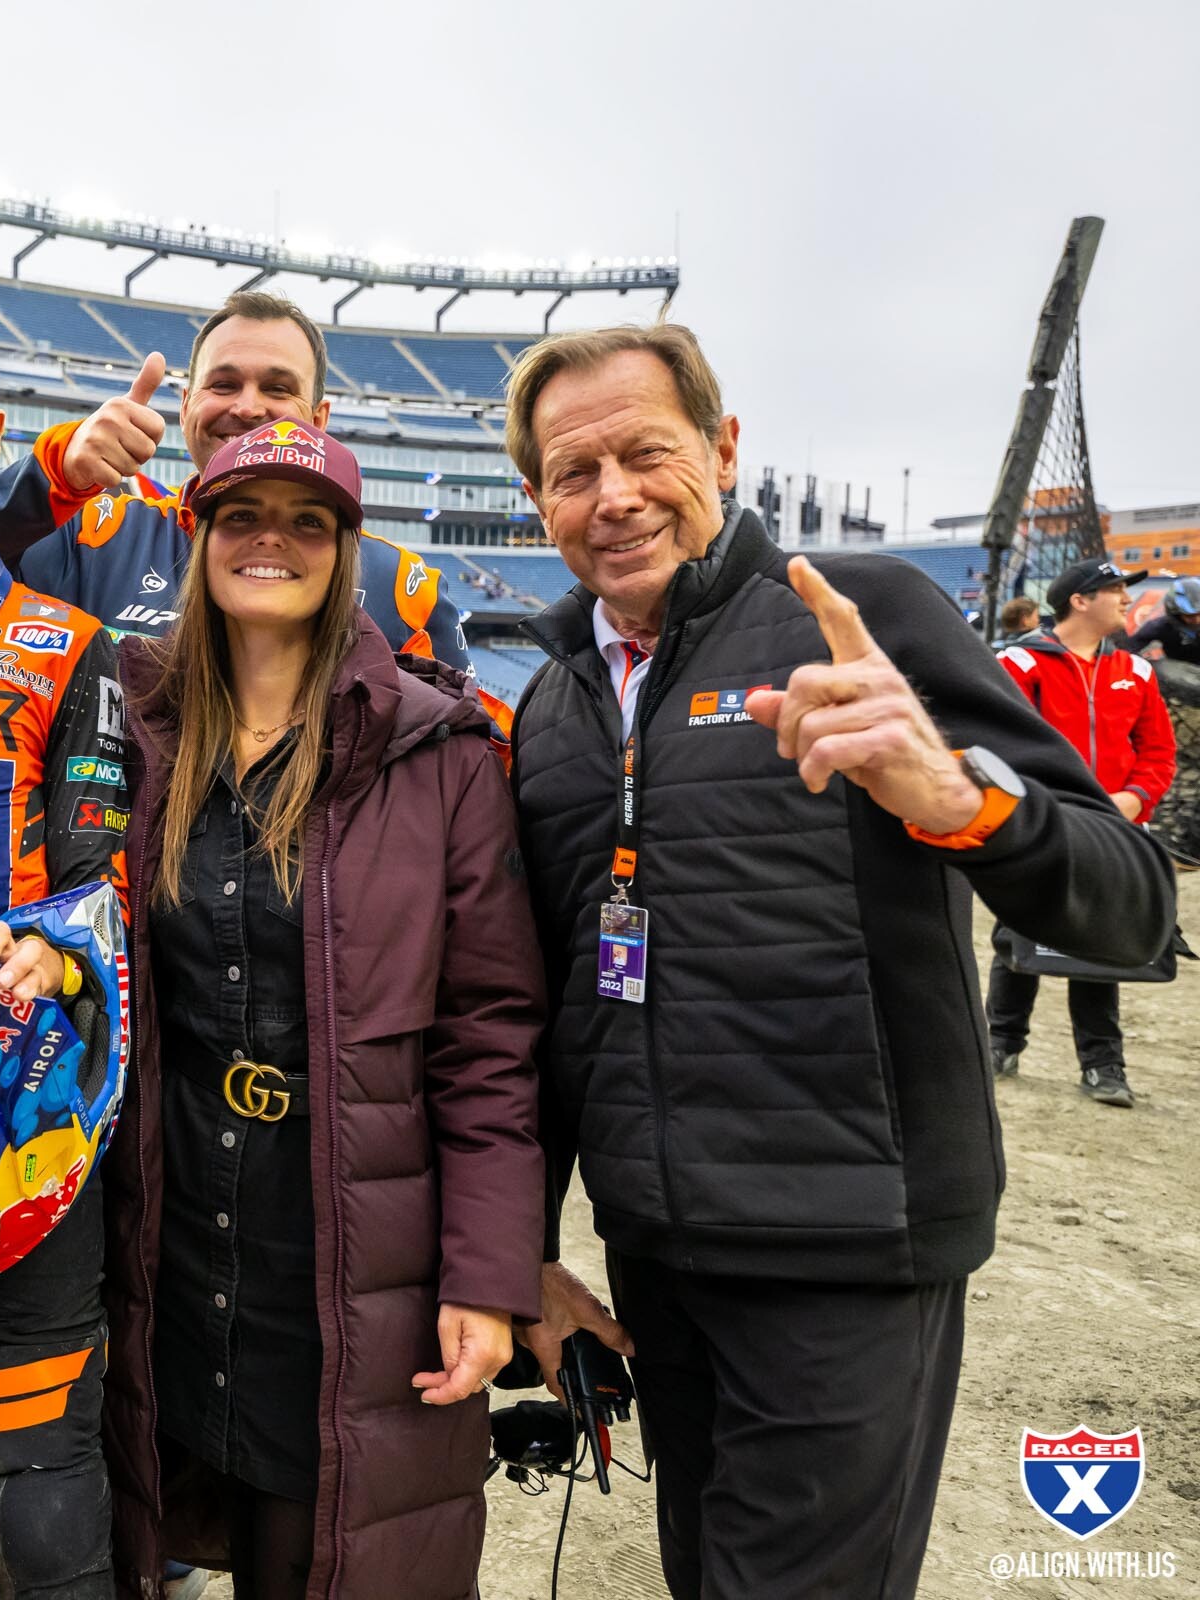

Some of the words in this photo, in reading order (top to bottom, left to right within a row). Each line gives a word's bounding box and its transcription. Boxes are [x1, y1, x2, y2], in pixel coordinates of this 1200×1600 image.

[234, 446, 280, 468] Red
[281, 447, 325, 474] Bull
[14, 628, 64, 648] 100%
[688, 713, 733, 727] FACTORY
[733, 710, 755, 722] RAC
[624, 749, 634, 775] RACE
[624, 776, 634, 790] TO
[624, 791, 633, 826] READY
[599, 979, 622, 992] 2022
[23, 1030, 63, 1093] AIROH
